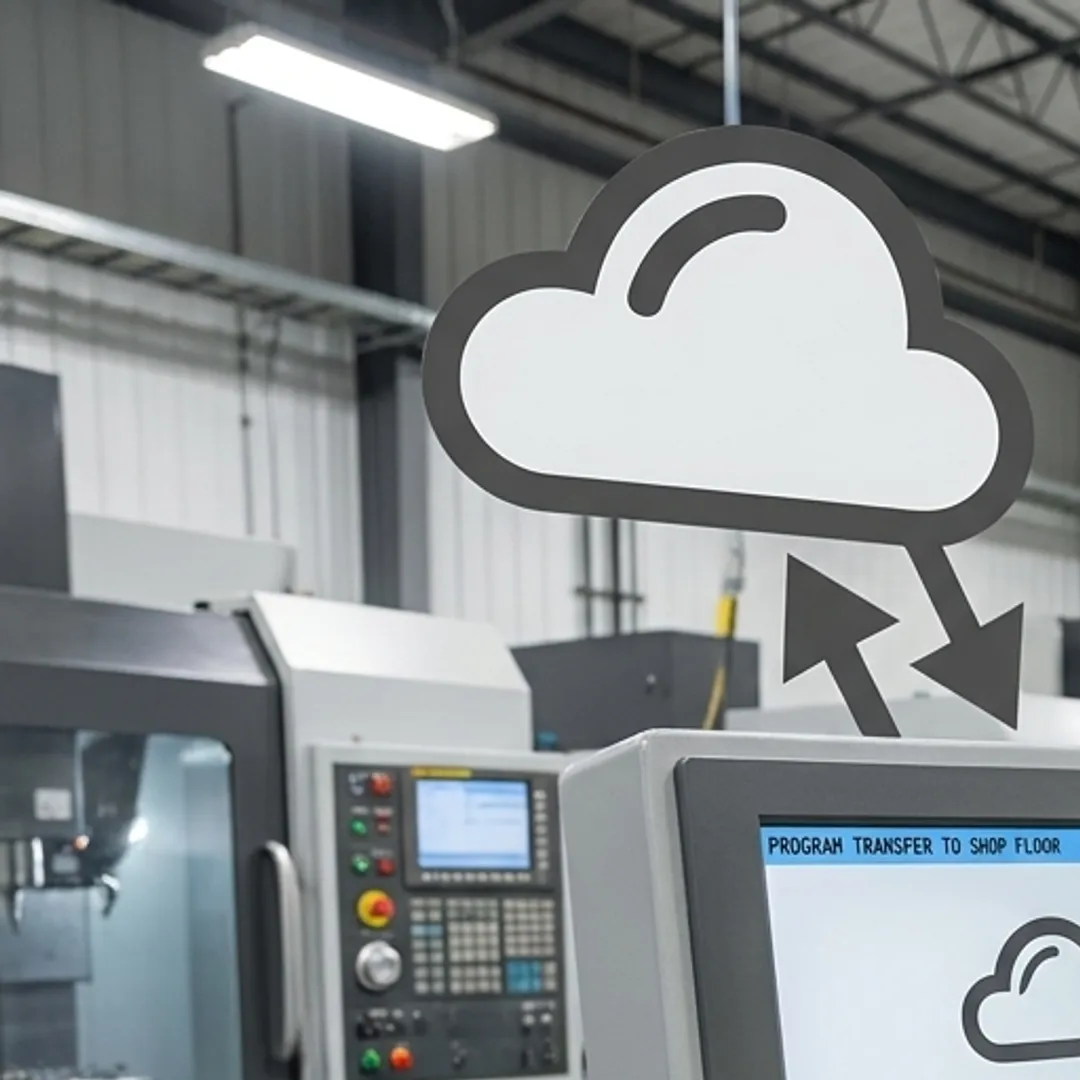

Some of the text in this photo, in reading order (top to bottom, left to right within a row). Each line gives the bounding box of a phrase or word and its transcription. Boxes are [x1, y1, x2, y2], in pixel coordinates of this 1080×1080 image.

[768, 836, 1061, 856] PROGRAM TRANSFER TO SHOP FLOOR
